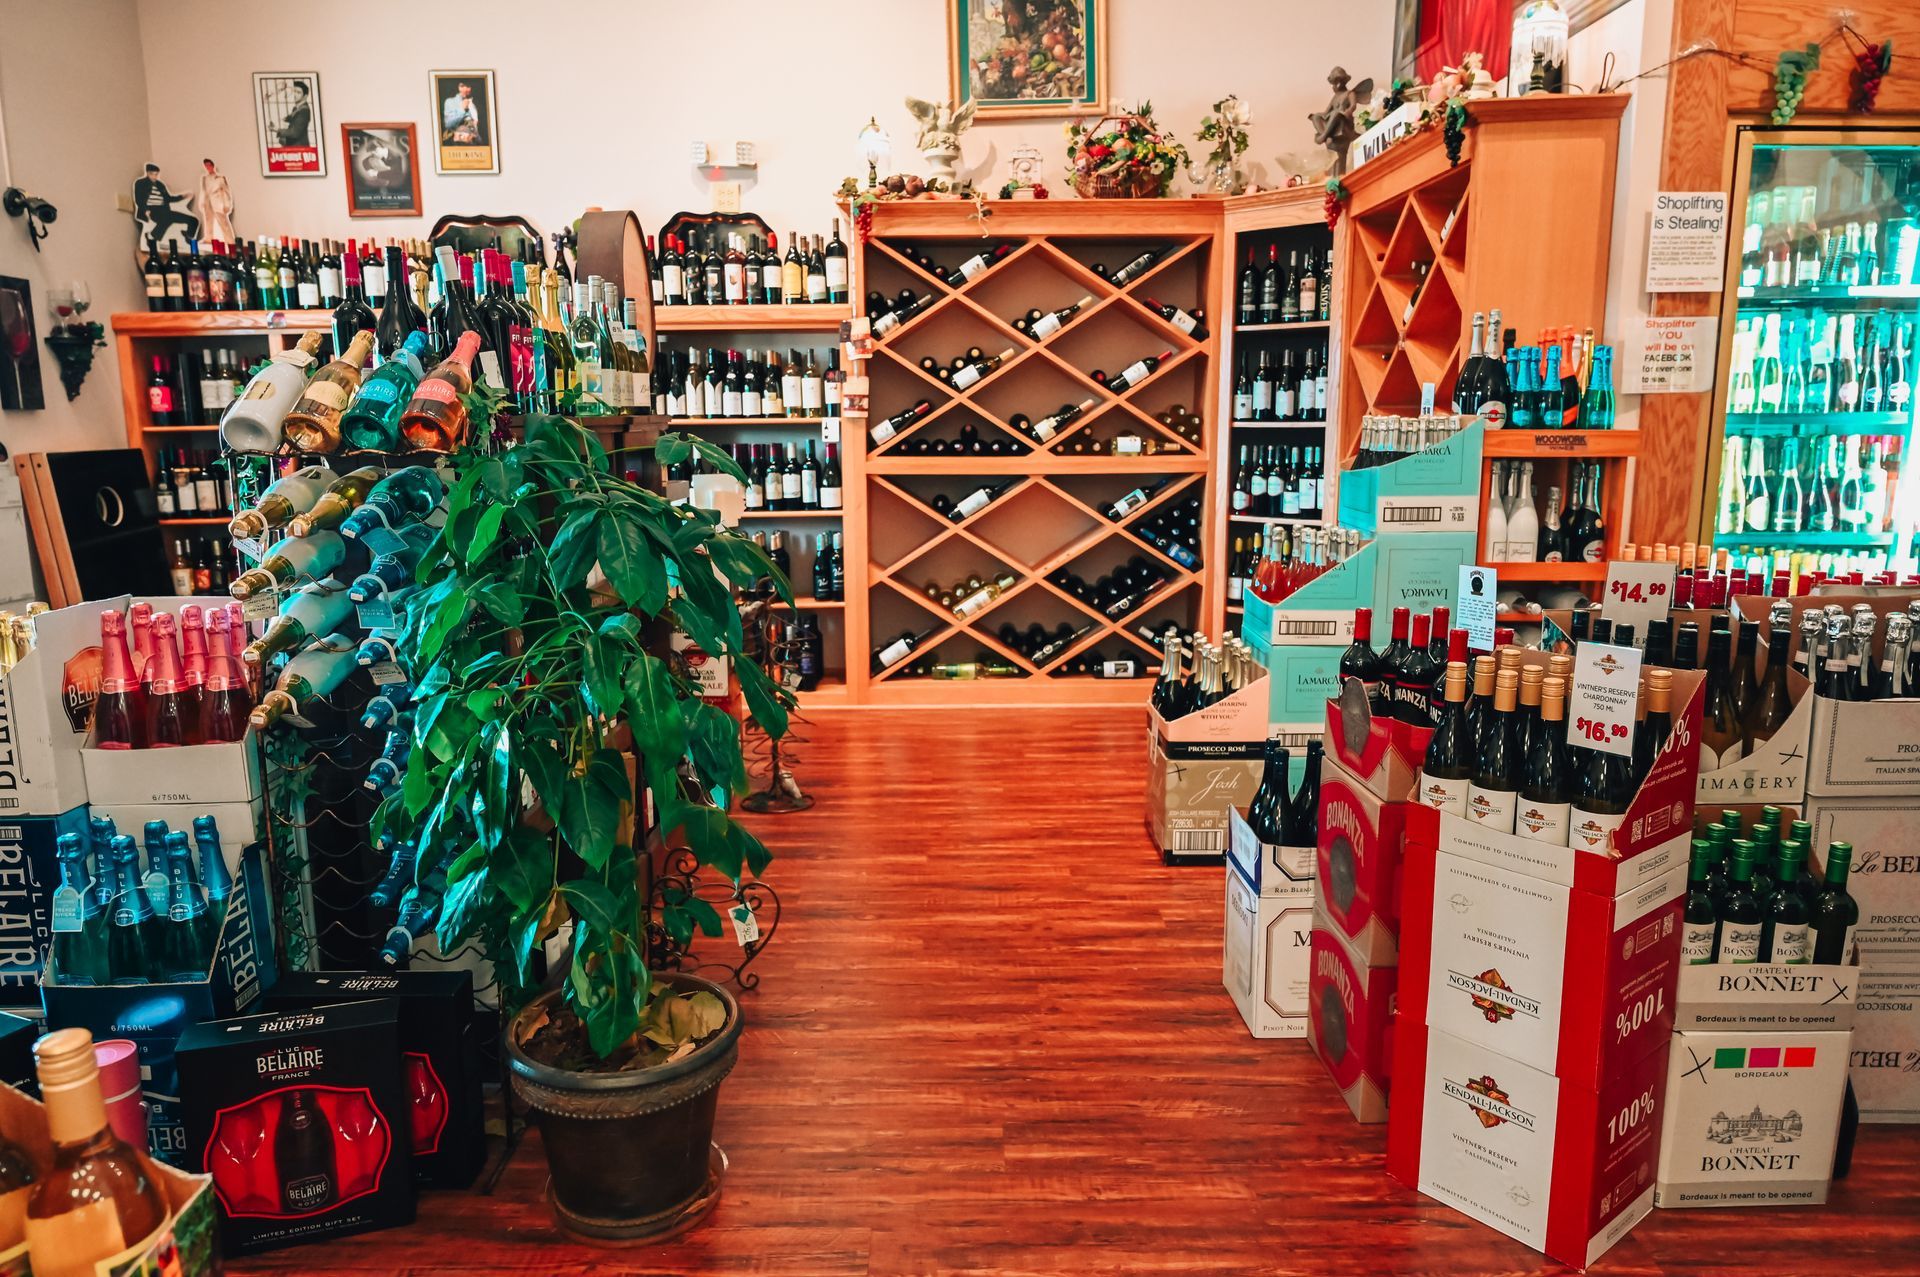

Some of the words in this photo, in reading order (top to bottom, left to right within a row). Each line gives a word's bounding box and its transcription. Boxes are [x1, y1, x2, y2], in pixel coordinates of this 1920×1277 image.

[1657, 196, 1724, 212] Shoplifting
[1654, 217, 1664, 229] is
[1668, 216, 1723, 232] Stealing!
[1645, 320, 1697, 330] Shoplifter
[1658, 331, 1683, 340] YOU
[1645, 343, 1662, 351] will
[1664, 343, 1677, 351] be
[1642, 365, 1653, 373] for
[1655, 365, 1692, 374] everyone
[1535, 434, 1587, 445] WOODWORK
[1416, 445, 1451, 456] MARCA
[1610, 580, 1667, 603] $14.99
[1577, 682, 1608, 694] VINTNER'S
[1608, 688, 1636, 698] RESERVE
[1582, 692, 1628, 706] CHARDONNAY
[1593, 702, 1605, 711] 750
[1576, 717, 1629, 743] $16.99
[1228, 744, 1247, 752] ROSÉ
[1875, 767, 1906, 775] ITALIAN
[1188, 766, 1242, 806] Josh
[1700, 775, 1798, 790] IMAGERY
[152, 793, 192, 801] 6/750ML
[1326, 801, 1365, 868] BONANZA
[1453, 837, 1491, 851] COMMITTED
[1493, 847, 1502, 855] TO
[1504, 851, 1558, 869] SUSTAINABILITY
[1851, 851, 1881, 876] La
[174, 868, 183, 899] BLEU
[1450, 868, 1499, 886] SUSTAINABILITY
[1501, 882, 1510, 890] TO
[1512, 886, 1553, 902] COMMITTED
[32, 892, 49, 938] LUC
[1463, 933, 1492, 948] RESERVE
[1476, 927, 1516, 945] CALIFORNIA
[1493, 943, 1530, 960] VINTNER'S
[339, 979, 399, 989] BELAIRE
[1318, 950, 1355, 1025] BONANZA
[1718, 975, 1824, 992] BONNET
[1449, 974, 1539, 1015] KENDALL-JACKSON
[1857, 1003, 1912, 1011] PROSECCO
[1616, 987, 1665, 1045] 100%
[1695, 1015, 1737, 1023] Bordeaux
[1739, 1015, 1747, 1023] is
[1748, 1015, 1776, 1023] meant
[1778, 1015, 1788, 1023] to
[1789, 1015, 1800, 1023] be
[1802, 1015, 1835, 1024] opened
[110, 1024, 153, 1032] 6/750ML
[258, 1016, 325, 1033] BELAIRE
[1263, 1024, 1284, 1032] PINOT
[278, 1046, 300, 1054] LUC
[256, 1049, 324, 1074] BELAIRE
[271, 1071, 311, 1081] FRANCE
[1734, 1070, 1790, 1079] BORDEAUX
[1444, 1081, 1535, 1128] KENDALL-JACKSON
[1608, 1084, 1655, 1145] 100%
[1452, 1132, 1487, 1154] VINTNER'S
[1488, 1149, 1519, 1168] RESERVE
[1464, 1149, 1504, 1171] CALIFORNIA
[1700, 1154, 1800, 1171] BONNET
[289, 1181, 327, 1200] BELAIRE
[1680, 1192, 1719, 1201] Bordeaux
[1720, 1192, 1728, 1200] is
[1729, 1192, 1755, 1200] meant
[1767, 1191, 1779, 1199] be
[1780, 1191, 1813, 1200] opened
[1431, 1181, 1468, 1203] COMMITTED
[1470, 1199, 1478, 1207] TO
[1480, 1205, 1531, 1233] SUSTAINABILITY
[253, 1230, 286, 1240] LIMITED
[289, 1223, 321, 1234] EDITION
[325, 1219, 343, 1227] GIFT
[346, 1215, 362, 1223] SET
